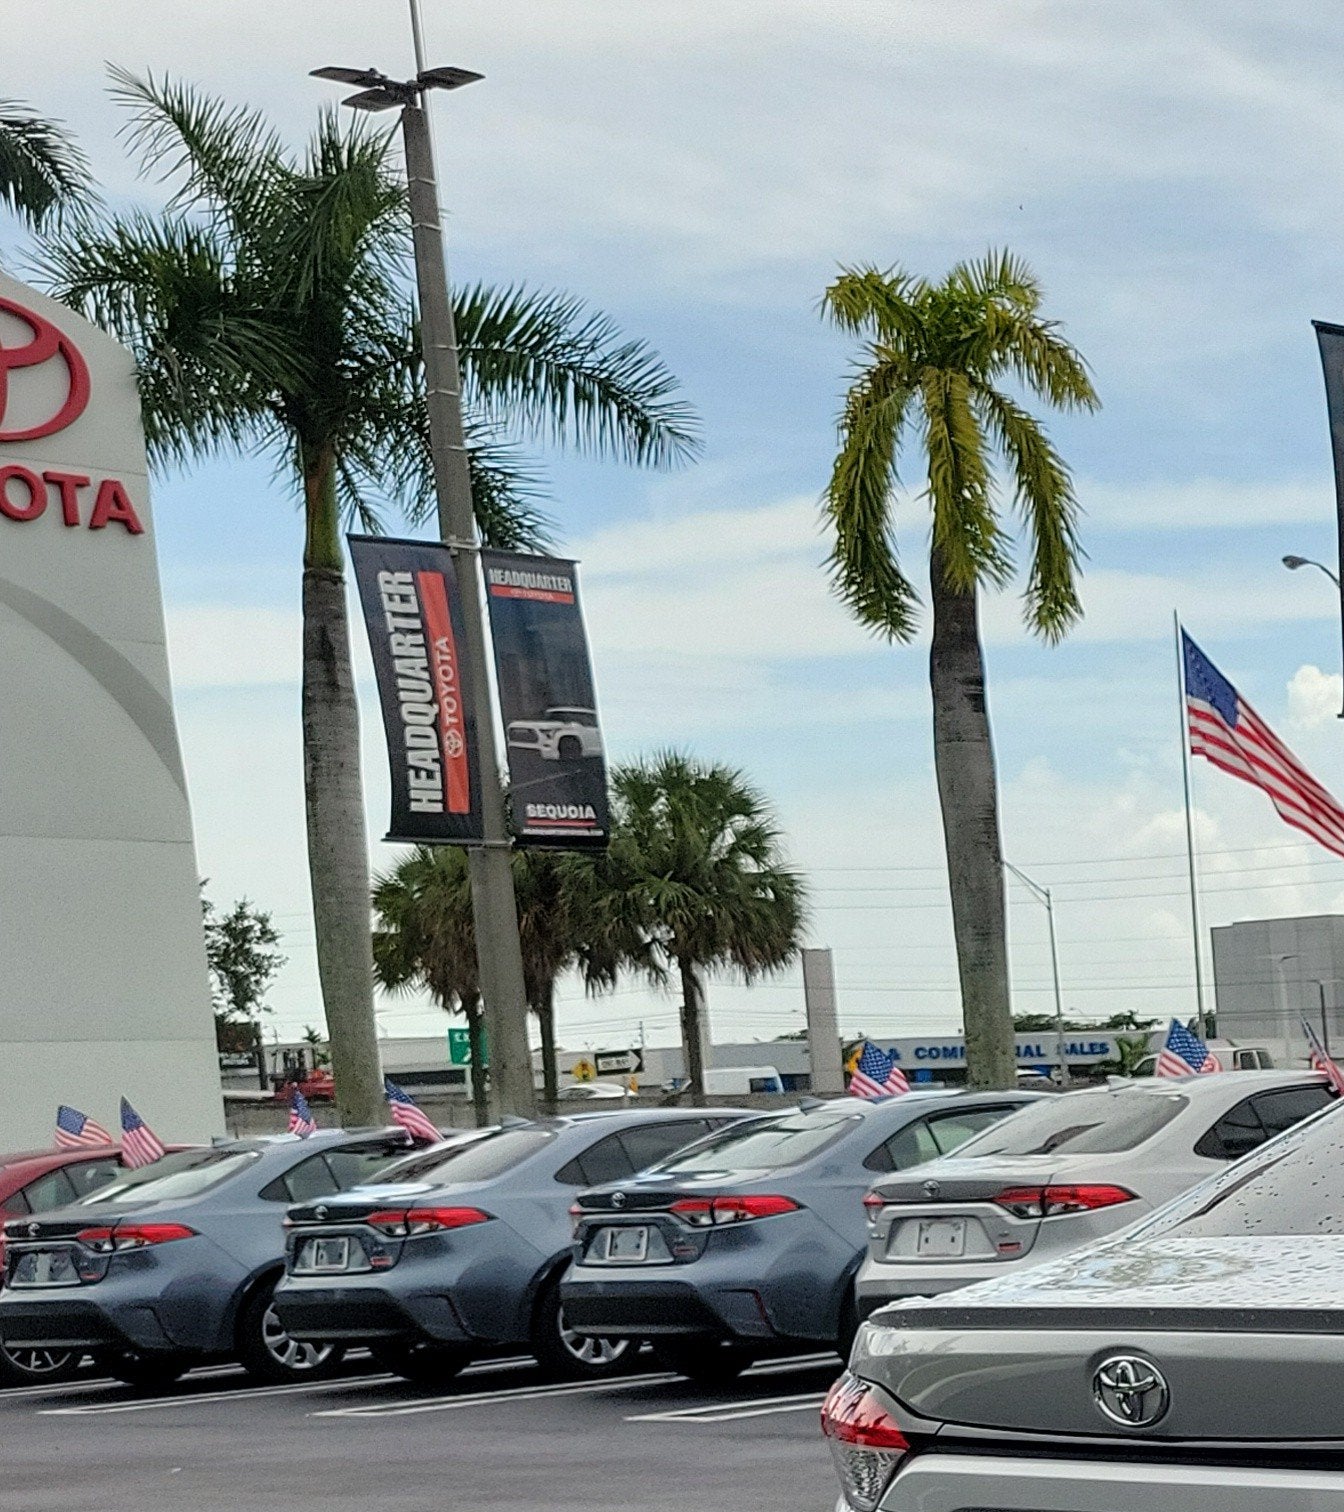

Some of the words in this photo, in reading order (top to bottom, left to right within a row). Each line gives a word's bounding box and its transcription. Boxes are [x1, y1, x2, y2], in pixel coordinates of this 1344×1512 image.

[488, 568, 573, 593] HEADQUARTER
[378, 570, 444, 813] HEADQUARTER
[434, 636, 460, 726] TOYOTA
[526, 803, 597, 820] SEQUOIA
[914, 1043, 1046, 1061] COMIAL
